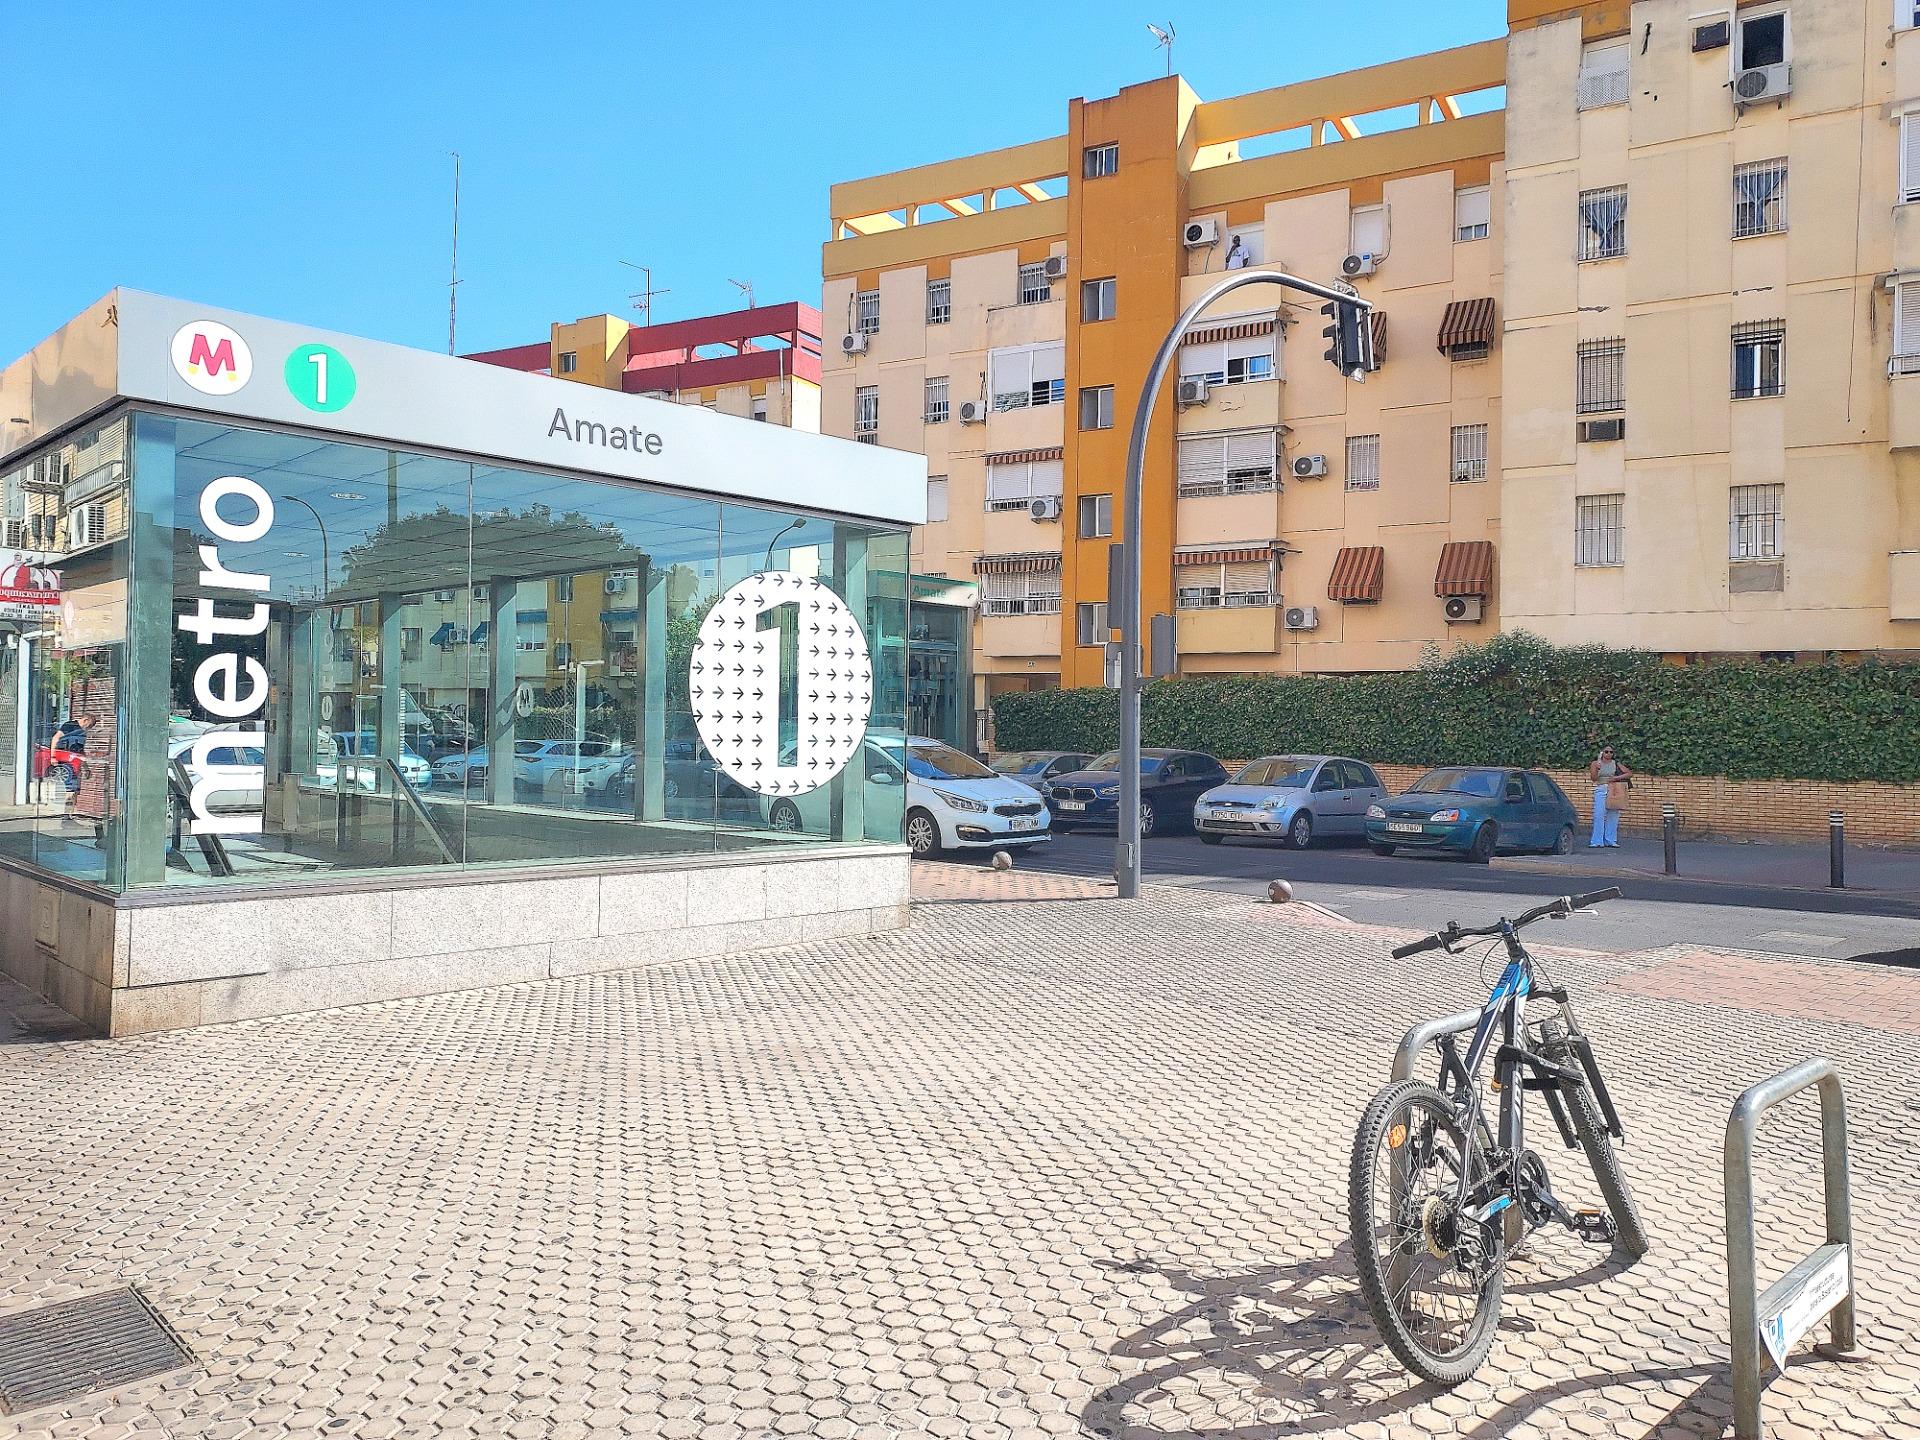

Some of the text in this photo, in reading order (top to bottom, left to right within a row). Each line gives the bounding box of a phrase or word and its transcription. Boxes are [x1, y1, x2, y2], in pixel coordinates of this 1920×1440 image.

[188, 333, 236, 377] M
[307, 352, 327, 405] 1
[547, 407, 663, 456] Amate
[912, 584, 947, 599] Amate
[178, 475, 275, 835] metro
[756, 601, 800, 768] 1
